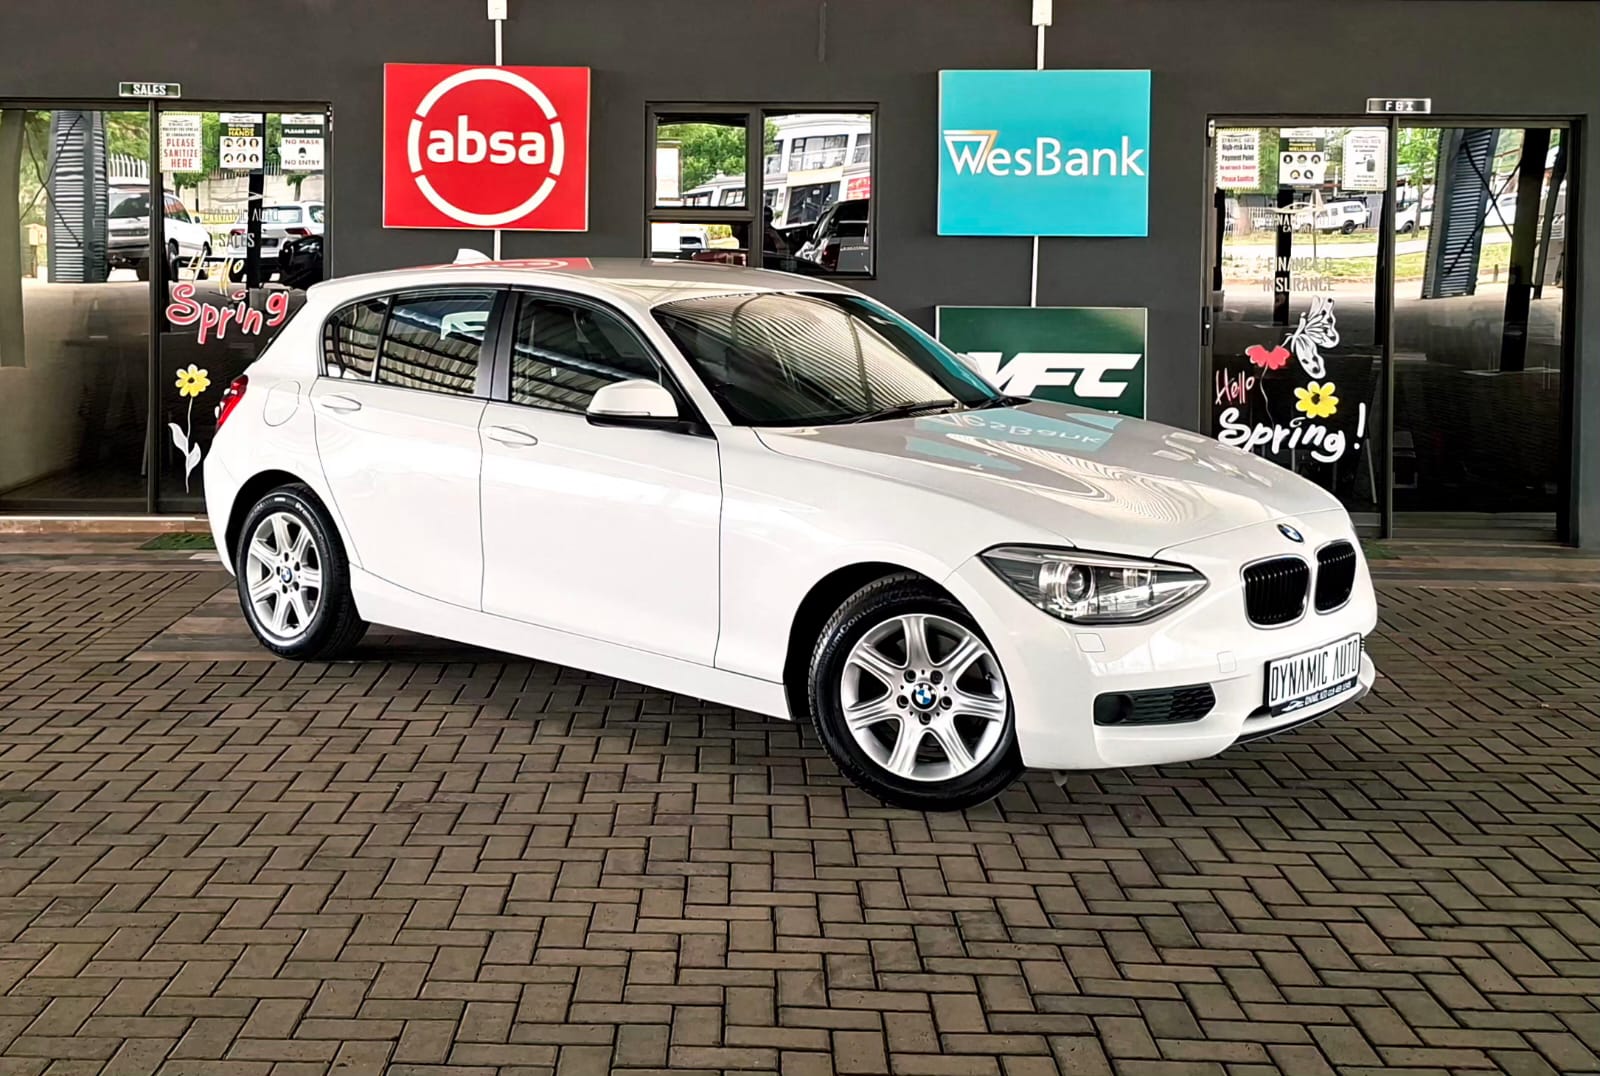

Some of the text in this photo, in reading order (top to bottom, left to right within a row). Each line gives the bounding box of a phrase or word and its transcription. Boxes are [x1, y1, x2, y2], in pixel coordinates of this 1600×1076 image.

[133, 84, 166, 96] SALES
[166, 138, 195, 147] PLEASE
[426, 115, 545, 165] absa
[163, 149, 198, 157] SANITIZE
[943, 130, 1145, 176] WesBank
[171, 159, 193, 168] HERE
[252, 208, 279, 221] AUTO
[218, 233, 255, 248] SALES
[1267, 256, 1322, 272] FINANCE
[1263, 277, 1335, 292] INSURANCE
[166, 284, 289, 344] Spring
[1215, 368, 1255, 405] Hello
[1271, 651, 1328, 701] DYNAMIC
[1333, 639, 1357, 680] AUTO
